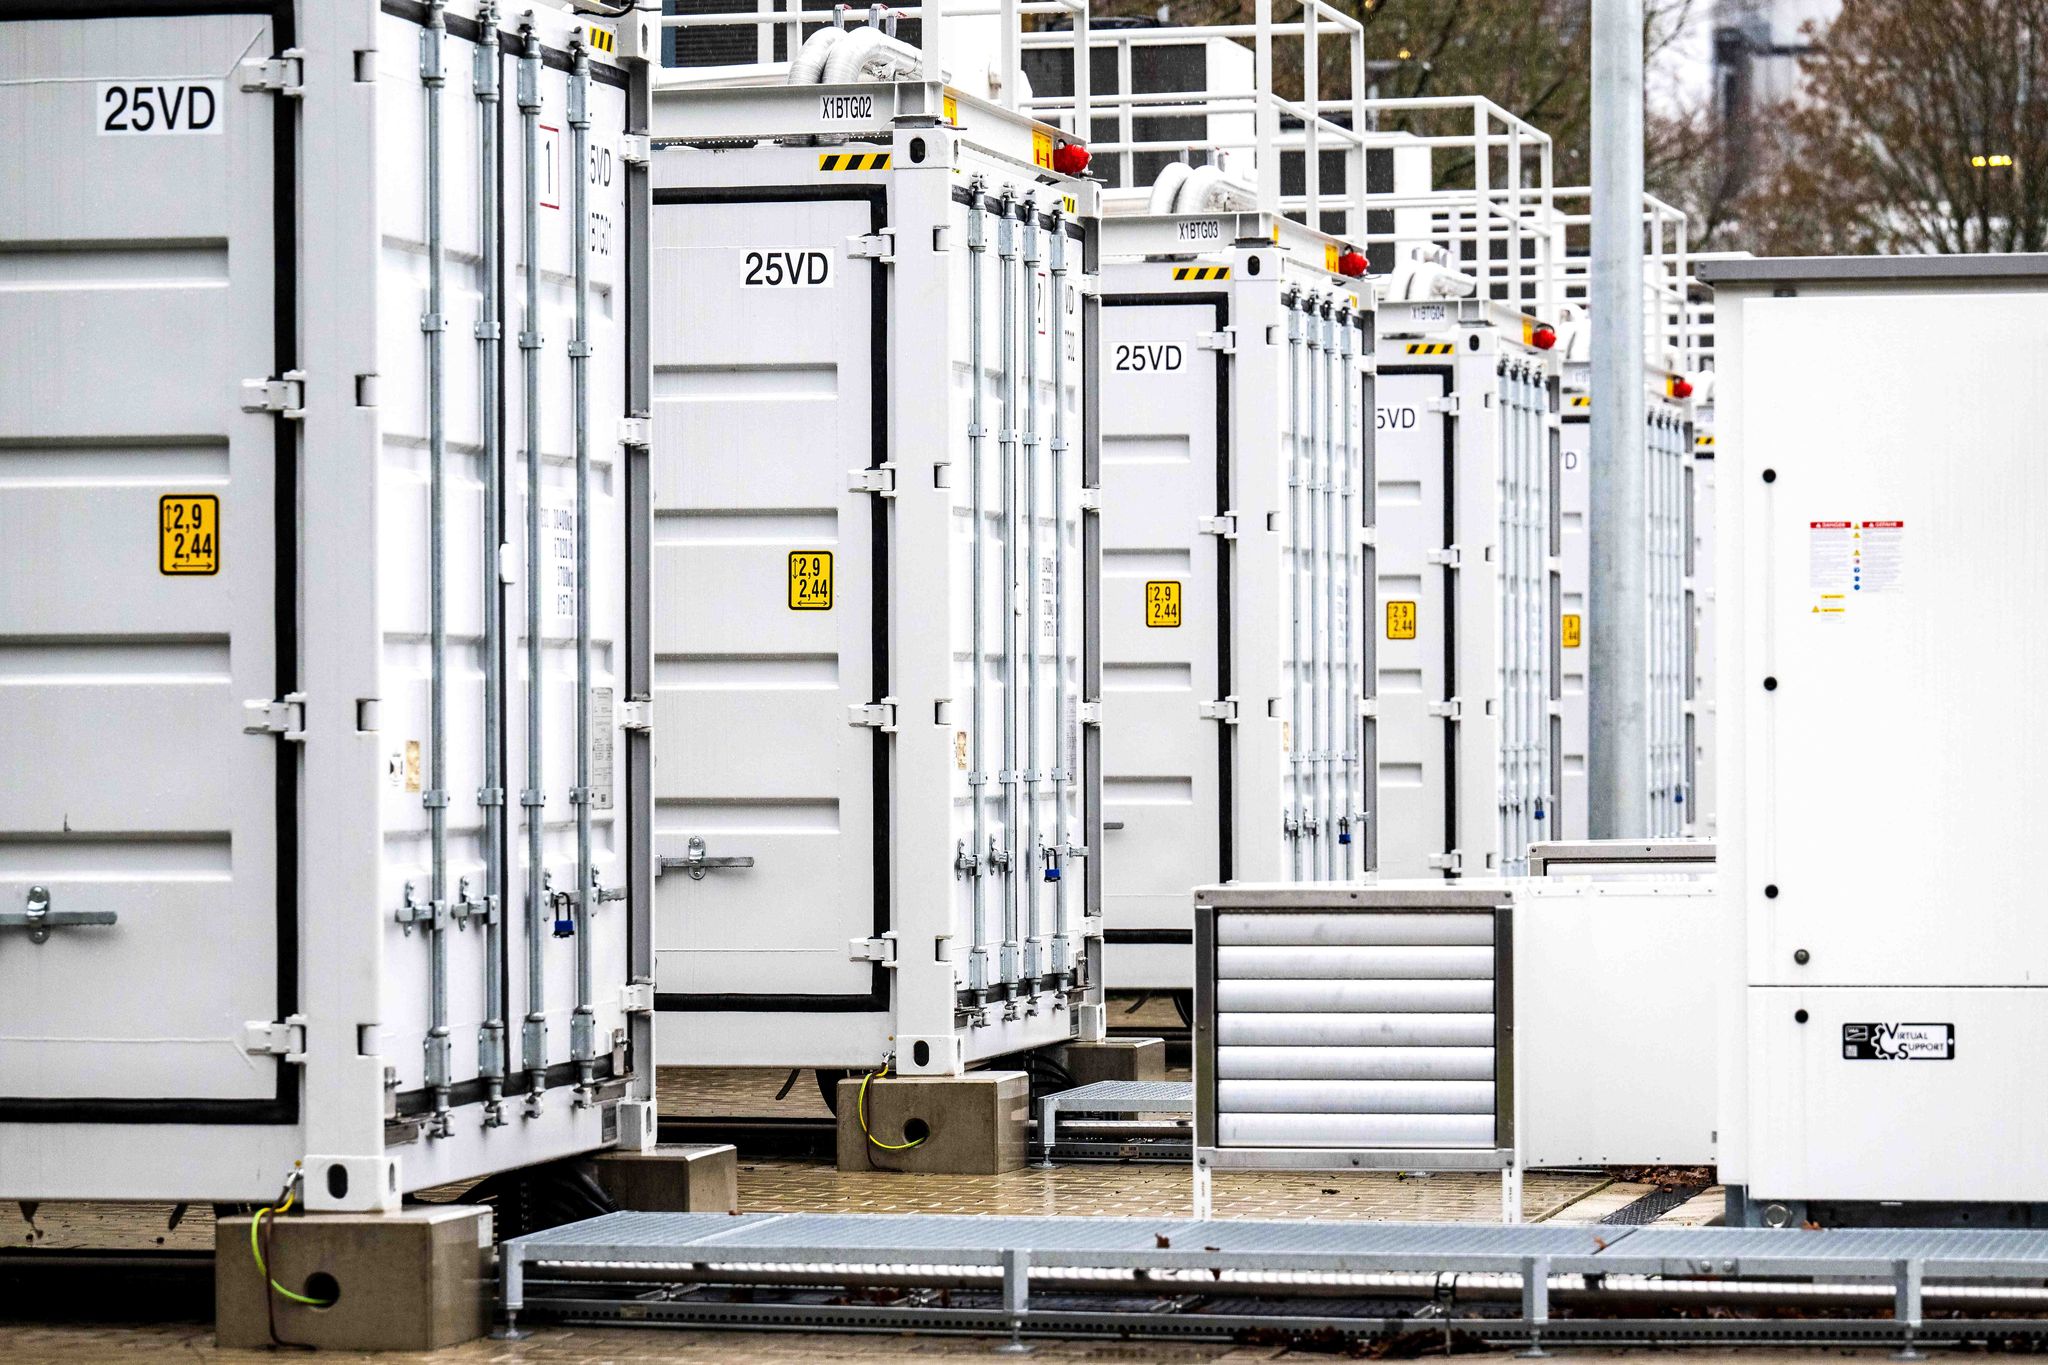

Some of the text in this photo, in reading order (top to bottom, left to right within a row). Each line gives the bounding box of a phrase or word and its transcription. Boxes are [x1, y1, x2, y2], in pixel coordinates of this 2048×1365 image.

[104, 85, 215, 132] 25VD
[822, 96, 872, 119] X1BTG02
[1178, 220, 1219, 240] X1BTG03
[745, 251, 829, 286] 25VD
[1116, 344, 1182, 371] 25VD
[173, 503, 203, 533] 2,9
[174, 533, 213, 563] 2,44
[799, 557, 821, 579] 2,9
[799, 578, 828, 601] 2,44
[1154, 585, 1171, 603] 2,9
[1154, 603, 1177, 620] 2,44
[1885, 1022, 1929, 1040] VIRTUAL
[1897, 1042, 1945, 1060] SUPPORT
